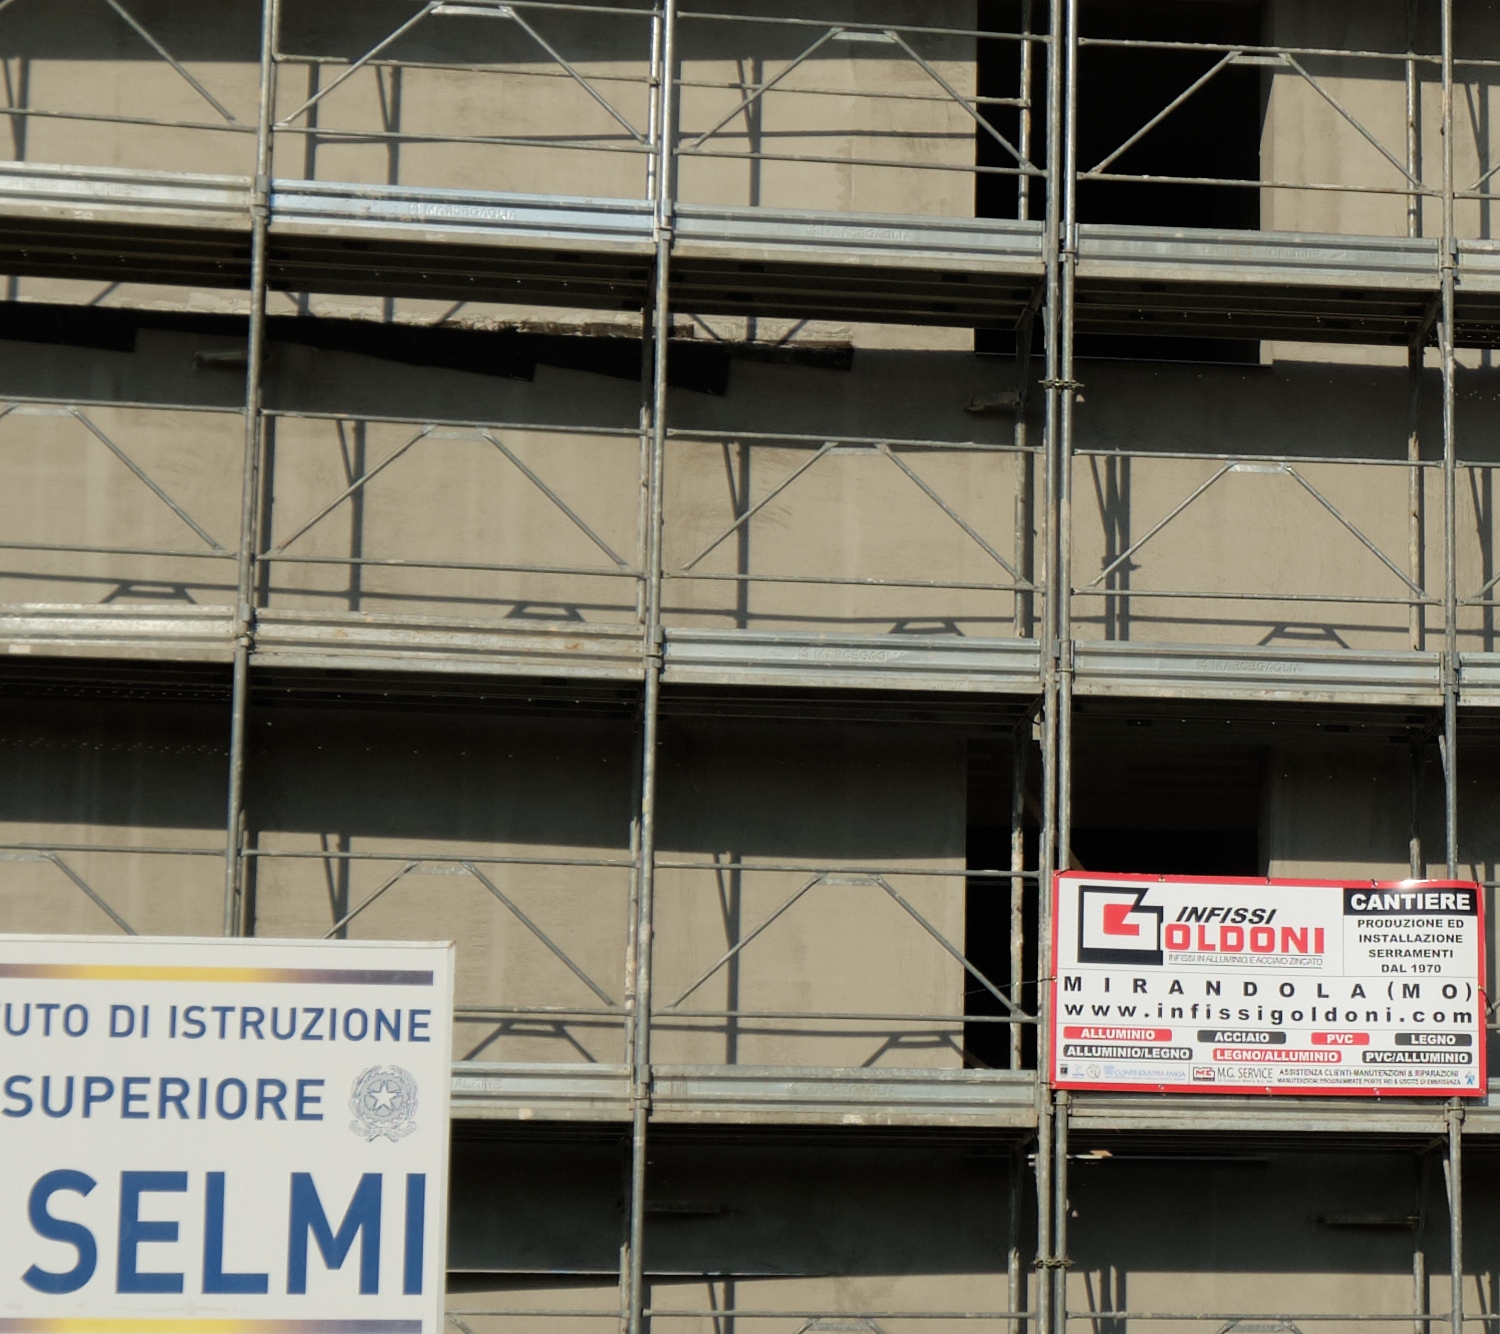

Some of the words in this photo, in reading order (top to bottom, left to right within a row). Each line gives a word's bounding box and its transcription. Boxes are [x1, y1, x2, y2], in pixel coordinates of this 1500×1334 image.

[1350, 893, 1471, 911] CANTIERE
[1175, 906, 1277, 925] INFISSI
[1357, 919, 1444, 928] PRODUZIONE
[1448, 919, 1465, 928] ED
[1359, 934, 1463, 943] INSTALLAZIONE
[1169, 954, 1196, 962] INFISSI
[1197, 954, 1205, 962] IN
[1205, 955, 1248, 964] ALLUMINIO
[1256, 957, 1288, 965] ACCIAIO
[1289, 957, 1323, 966] ZINCATO
[1368, 949, 1454, 958] SERRAMENTI
[1381, 964, 1407, 973] DAL
[1411, 964, 1442, 973] 1970
[1063, 976, 1366, 1000] MIRANDOLA
[1387, 981, 1473, 1002] (MO)
[1063, 1002, 1474, 1026] www.infissigoldoni.com
[108, 1004, 150, 1039] DI
[168, 1005, 432, 1043] ISTRUZIONE
[1080, 1028, 1156, 1040] ALLUMINIO
[1214, 1031, 1270, 1044] ACCIAIO
[1326, 1033, 1354, 1044] PVC
[1410, 1033, 1457, 1045] LEGNO
[1066, 1045, 1191, 1060] ALLUMINIO/LEGNO
[1216, 1048, 1339, 1062] LEGNO/ALLUMINIO
[1365, 1050, 1470, 1064] PVC/ALLUMINIO
[1217, 1067, 1235, 1078] M.G.
[1238, 1067, 1273, 1079] SERVICE
[1279, 1069, 1323, 1077] ASSISTENZA
[1415, 1070, 1459, 1078] RIPARAZIONI
[0, 1075, 325, 1121] SUPERIORE
[21, 1169, 427, 1296] SELMI
